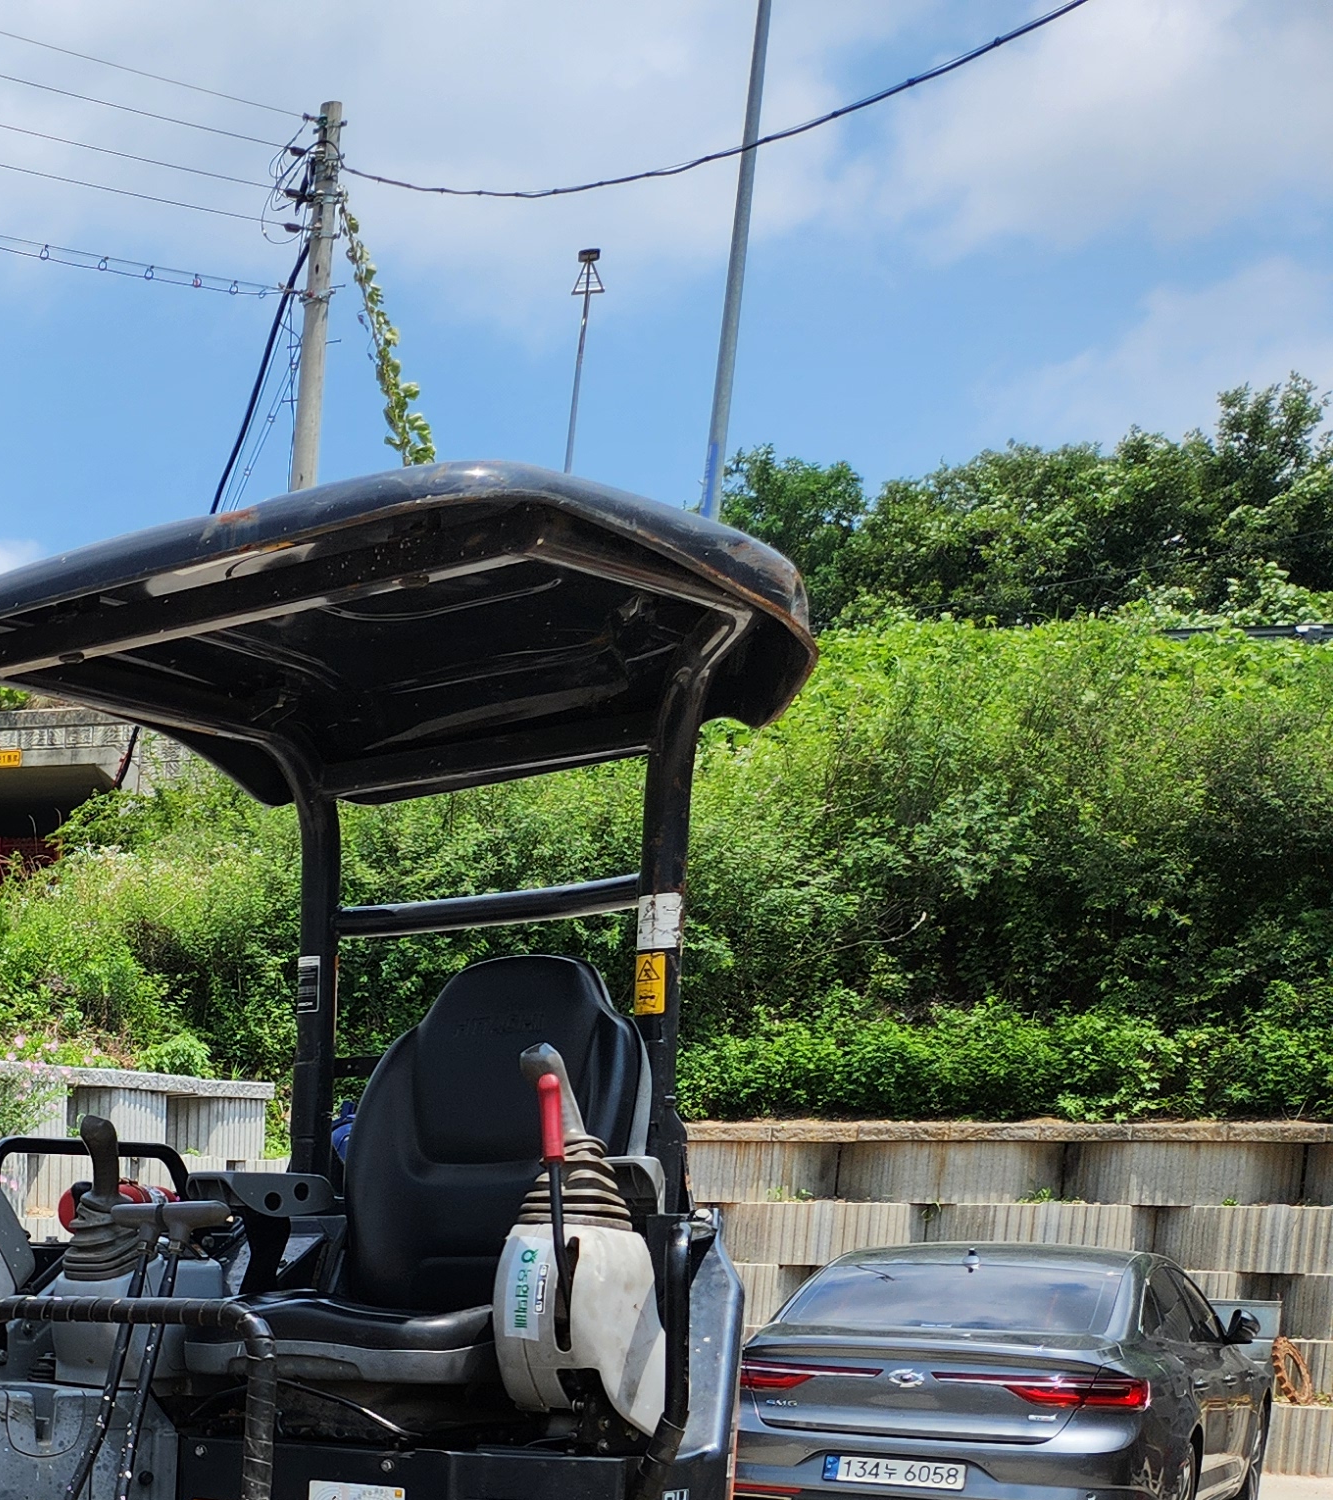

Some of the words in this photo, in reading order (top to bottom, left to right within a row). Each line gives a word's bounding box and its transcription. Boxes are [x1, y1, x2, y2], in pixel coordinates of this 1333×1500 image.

[514, 1269, 532, 1329] 농협택배
[843, 1460, 899, 1479] 134누
[904, 1465, 959, 1485] 6058
